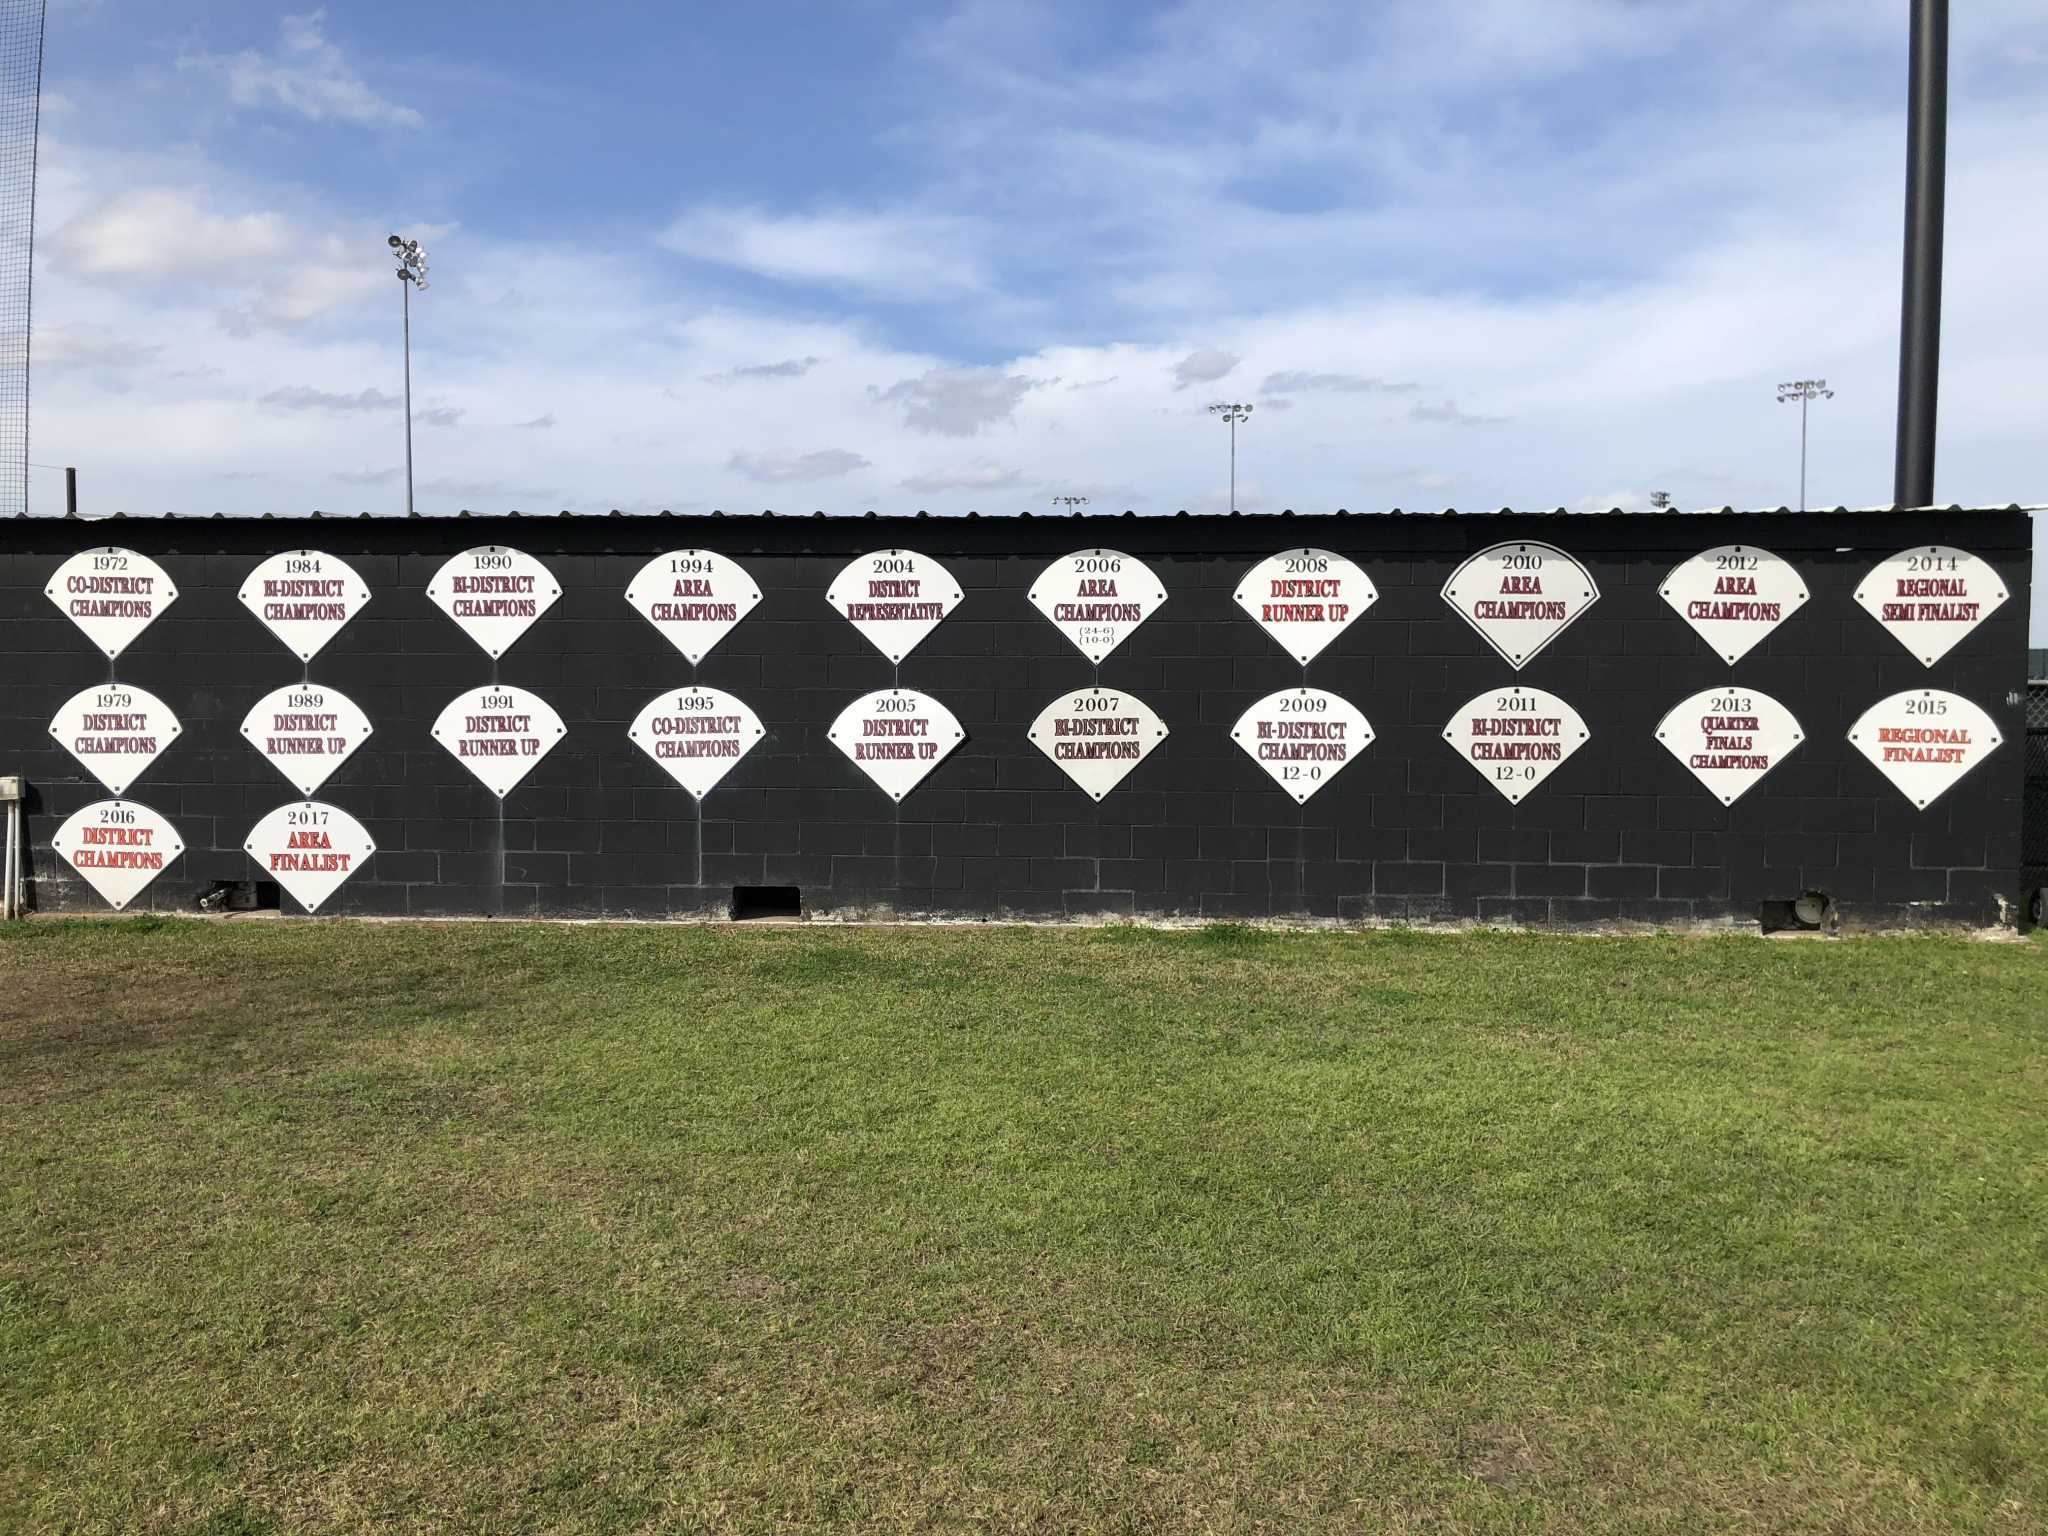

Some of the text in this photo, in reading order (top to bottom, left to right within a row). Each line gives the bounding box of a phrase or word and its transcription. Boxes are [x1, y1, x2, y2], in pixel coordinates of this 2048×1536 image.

[93, 556, 128, 571] 1972
[285, 559, 322, 574] 1984
[474, 555, 512, 569] 1990
[670, 559, 713, 574] 1994
[872, 559, 915, 573] 2004
[1075, 558, 1121, 573] 2006
[1285, 558, 1328, 573] 2008
[1502, 555, 1542, 570] 2010
[1716, 556, 1758, 571] 2012
[1907, 557, 1958, 572] 2014
[67, 576, 153, 595] CO-DISTRICT
[264, 580, 344, 597] BI-DISTRICT
[453, 576, 534, 594] BI-DISTRICT
[673, 580, 713, 597] AREA
[868, 580, 920, 597] DISTRICT
[1077, 579, 1117, 597] AREA
[1271, 580, 1340, 598] DISTRICT
[1499, 576, 1542, 594] AREA
[1714, 577, 1757, 595] AREA
[1896, 579, 1967, 597] REGIONAL
[70, 601, 152, 618] CHAMPIONS
[264, 603, 345, 621] CHAMPIONS
[453, 599, 536, 617] CHAMPIONS
[651, 603, 737, 621] CHAMPIONS
[847, 603, 943, 621] REPRESENTATIVE
[1054, 604, 1141, 622] CHAMPIONS
[1262, 605, 1348, 622] RUNNER UP
[1474, 601, 1566, 620] CHAMPIONS
[1688, 602, 1780, 621] CHAMPIONS
[1882, 603, 1979, 621] SEMI FINALIST
[1079, 626, 1115, 636] (24-6)
[1079, 636, 1115, 645] (10-0)
[96, 694, 132, 707] 1979
[287, 694, 323, 708] 1989
[481, 695, 513, 709] 1991
[677, 696, 714, 711] 1995
[876, 698, 916, 713] 2005
[1074, 697, 1120, 712] 2007
[1279, 698, 1327, 713] 2009
[1497, 697, 1537, 712] 2011
[1711, 698, 1752, 712] 2013
[1905, 699, 1947, 714] 2015
[83, 714, 146, 731] DISTRICT
[274, 714, 337, 731] DISTRICT
[466, 716, 530, 733] DISTRICT
[652, 716, 741, 735] CO-DISTRICT
[863, 719, 928, 737] DISTRICT
[1055, 718, 1139, 737] BI-DISTRICT
[1257, 722, 1346, 740] BI-DISTRICT
[1472, 718, 1561, 736] BI-DISTRICT
[1701, 717, 1759, 735] QUARTER
[1706, 736, 1752, 750] FINALS
[1878, 728, 1971, 744] REGIONAL
[75, 737, 156, 754] CHAMPIONS
[267, 738, 346, 755] RUNNER UP
[459, 739, 540, 756] RUNNER UP
[656, 740, 740, 758] CHAMPIONS
[855, 743, 938, 760] RUNNER UP
[1055, 742, 1140, 760] CHAMPIONS
[1258, 742, 1346, 762] CHAMPIONS
[1471, 743, 1561, 761] CHAMPIONS
[1690, 755, 1768, 769] CHAMPIONS
[1883, 748, 1965, 763] FINALIST
[1282, 766, 1321, 781] 12-0
[1495, 766, 1535, 780] 12-0
[100, 810, 135, 824] 2016
[287, 811, 328, 825] 2017
[82, 827, 153, 846] DISTRICT
[287, 831, 331, 849] AREA
[73, 850, 163, 869] CHAMPIONS
[269, 853, 350, 872] FINALIST
